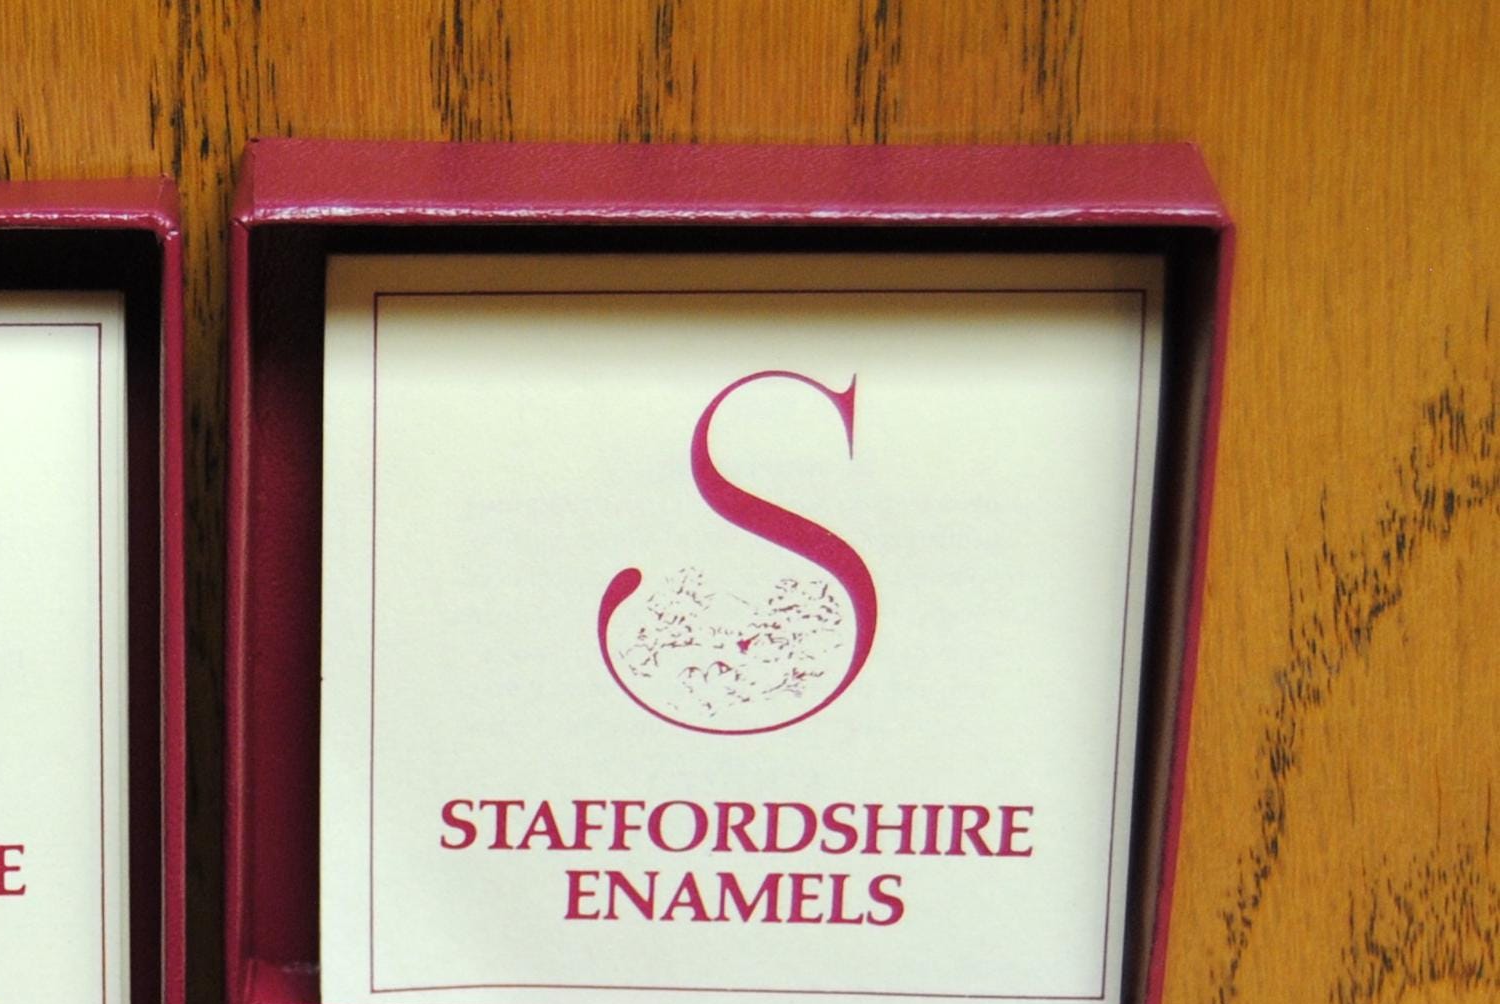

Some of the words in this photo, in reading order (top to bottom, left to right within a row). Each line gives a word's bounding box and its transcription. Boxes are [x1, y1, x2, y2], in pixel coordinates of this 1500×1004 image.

[598, 370, 878, 735] S
[440, 799, 1034, 858] STAFFORDSHIRE
[564, 870, 905, 926] ENAMELS
